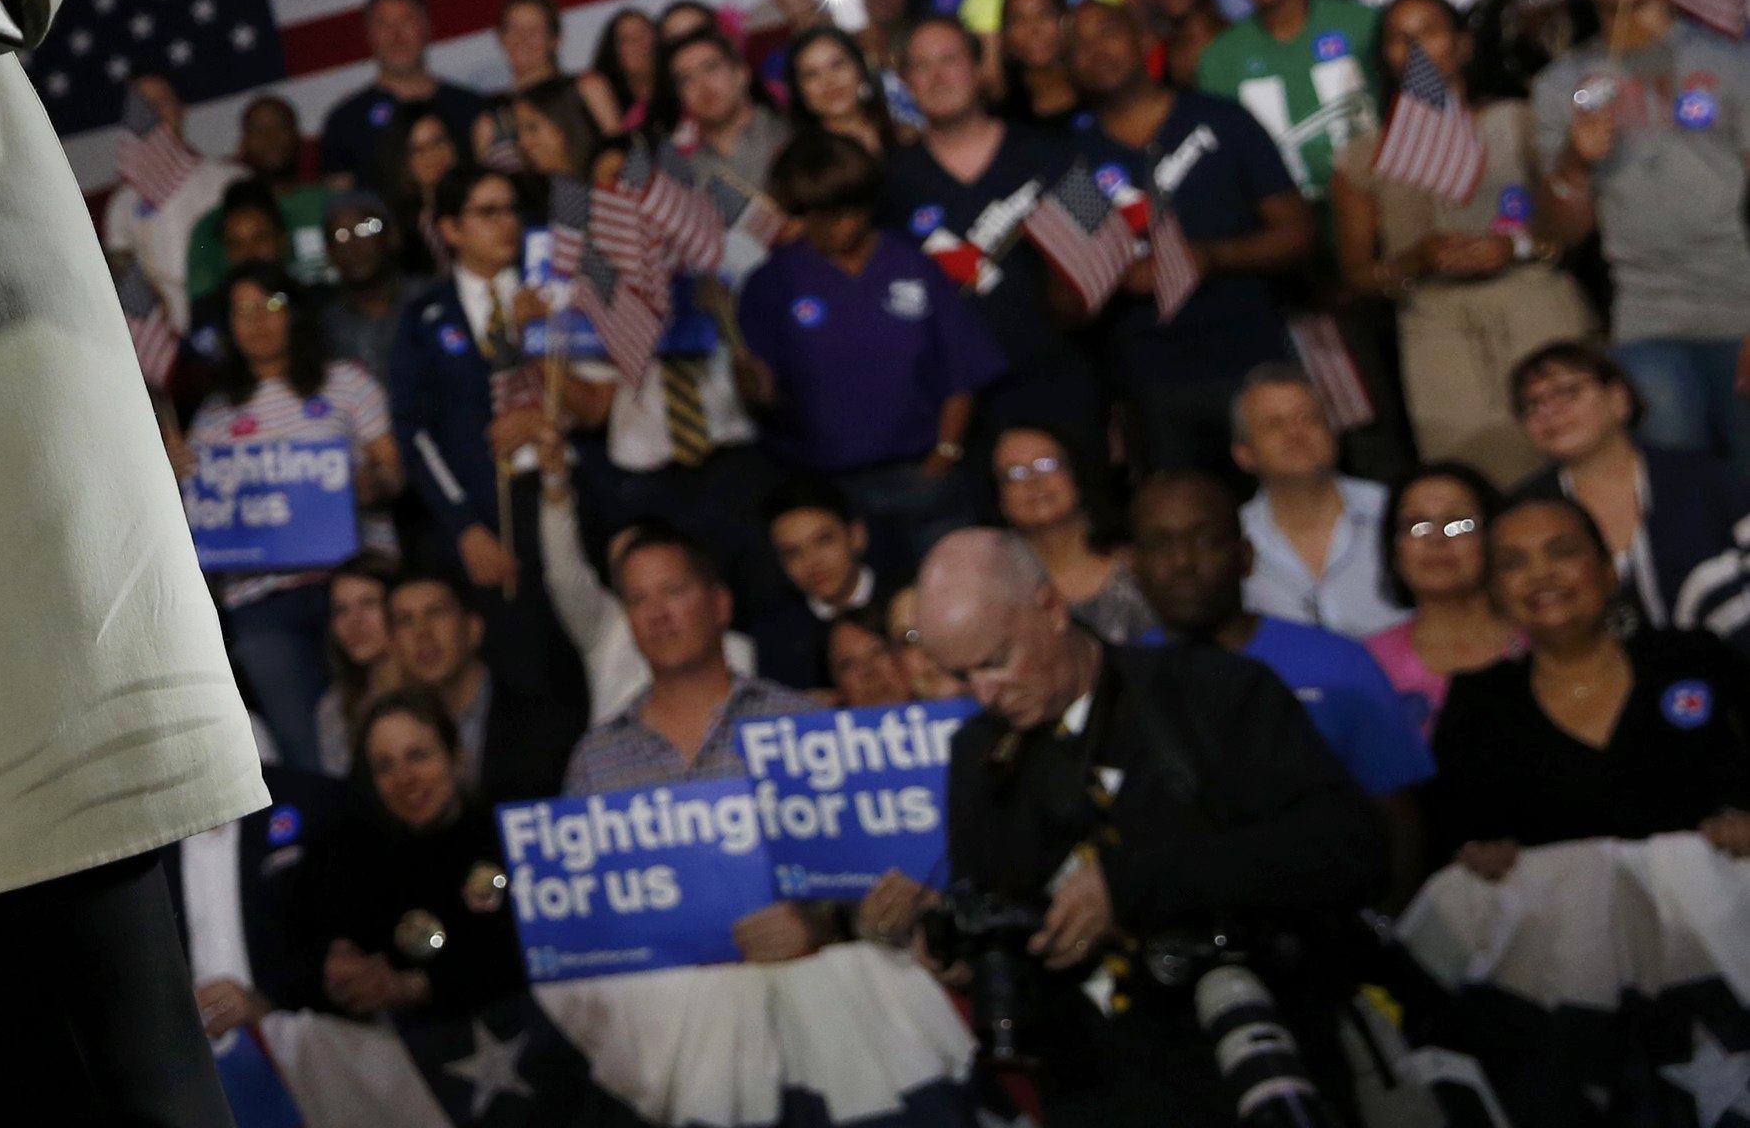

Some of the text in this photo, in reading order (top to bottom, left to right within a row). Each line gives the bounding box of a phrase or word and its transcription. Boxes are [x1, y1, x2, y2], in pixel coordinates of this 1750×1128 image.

[196, 442, 350, 493] ighting
[239, 490, 291, 528] us
[500, 787, 761, 871] Fighting
[755, 778, 942, 840] for us
[510, 864, 683, 922] for us
